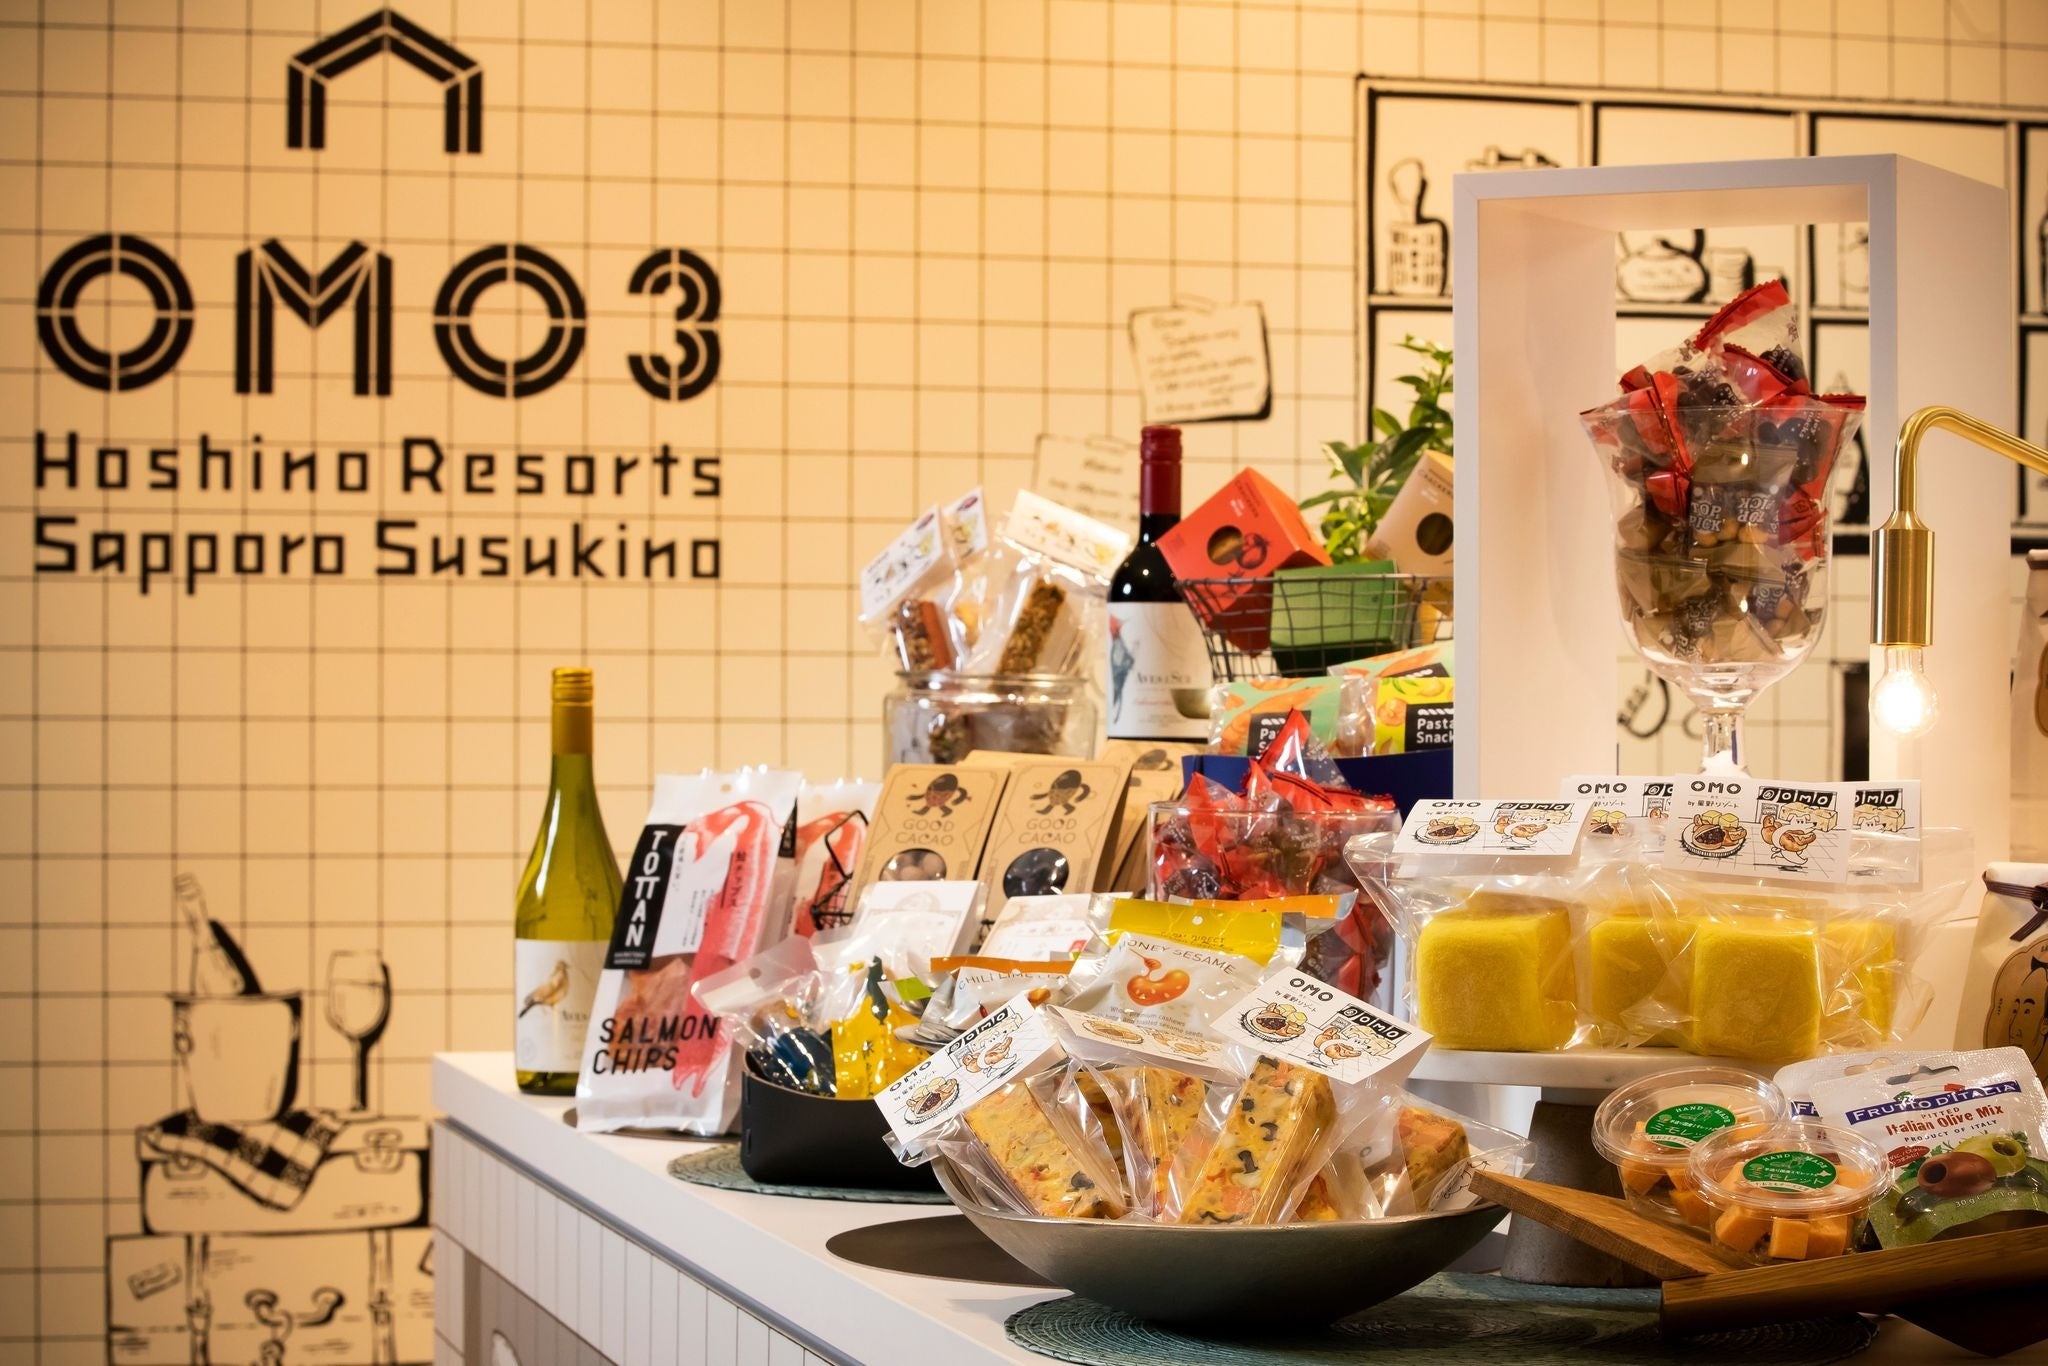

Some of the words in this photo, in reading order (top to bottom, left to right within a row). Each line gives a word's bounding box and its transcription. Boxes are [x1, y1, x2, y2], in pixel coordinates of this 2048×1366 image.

[35, 430, 368, 492] Hoshino
[402, 436, 721, 497] Resorts
[1692, 501, 1722, 518] TOP
[1738, 508, 1765, 524] TOP
[1689, 515, 1721, 532] PICK
[35, 516, 345, 596] Sapporo
[376, 519, 721, 579] Susukino
[1417, 717, 1454, 730] Pasta
[1577, 782, 1628, 795] OMO
[1690, 780, 1742, 795] OMO
[902, 818, 955, 832] GOOD
[1026, 817, 1078, 831] GOOD
[894, 832, 954, 845] CACAO
[1018, 832, 1076, 845] CACAO
[1172, 949, 1237, 975] SESAME
[1289, 978, 1334, 1002] OMO
[599, 1013, 722, 1044] SALMON
[592, 1048, 681, 1075] CHIPS
[889, 1060, 932, 1093] OMO
[1675, 1105, 1704, 1114] HAND
[1714, 1109, 1731, 1124] MADE
[1853, 1098, 1932, 1123] FRUTTO
[1921, 1106, 1961, 1120] PITTED
[1885, 1119, 1936, 1138] Italian
[1936, 1112, 1974, 1129] Olive
[1978, 1104, 2005, 1120] Mix
[1954, 1127, 1967, 1135] OF
[1971, 1119, 1998, 1132] ITALY
[1762, 1153, 1791, 1163] HAND
[1806, 1155, 1829, 1169] MADE
